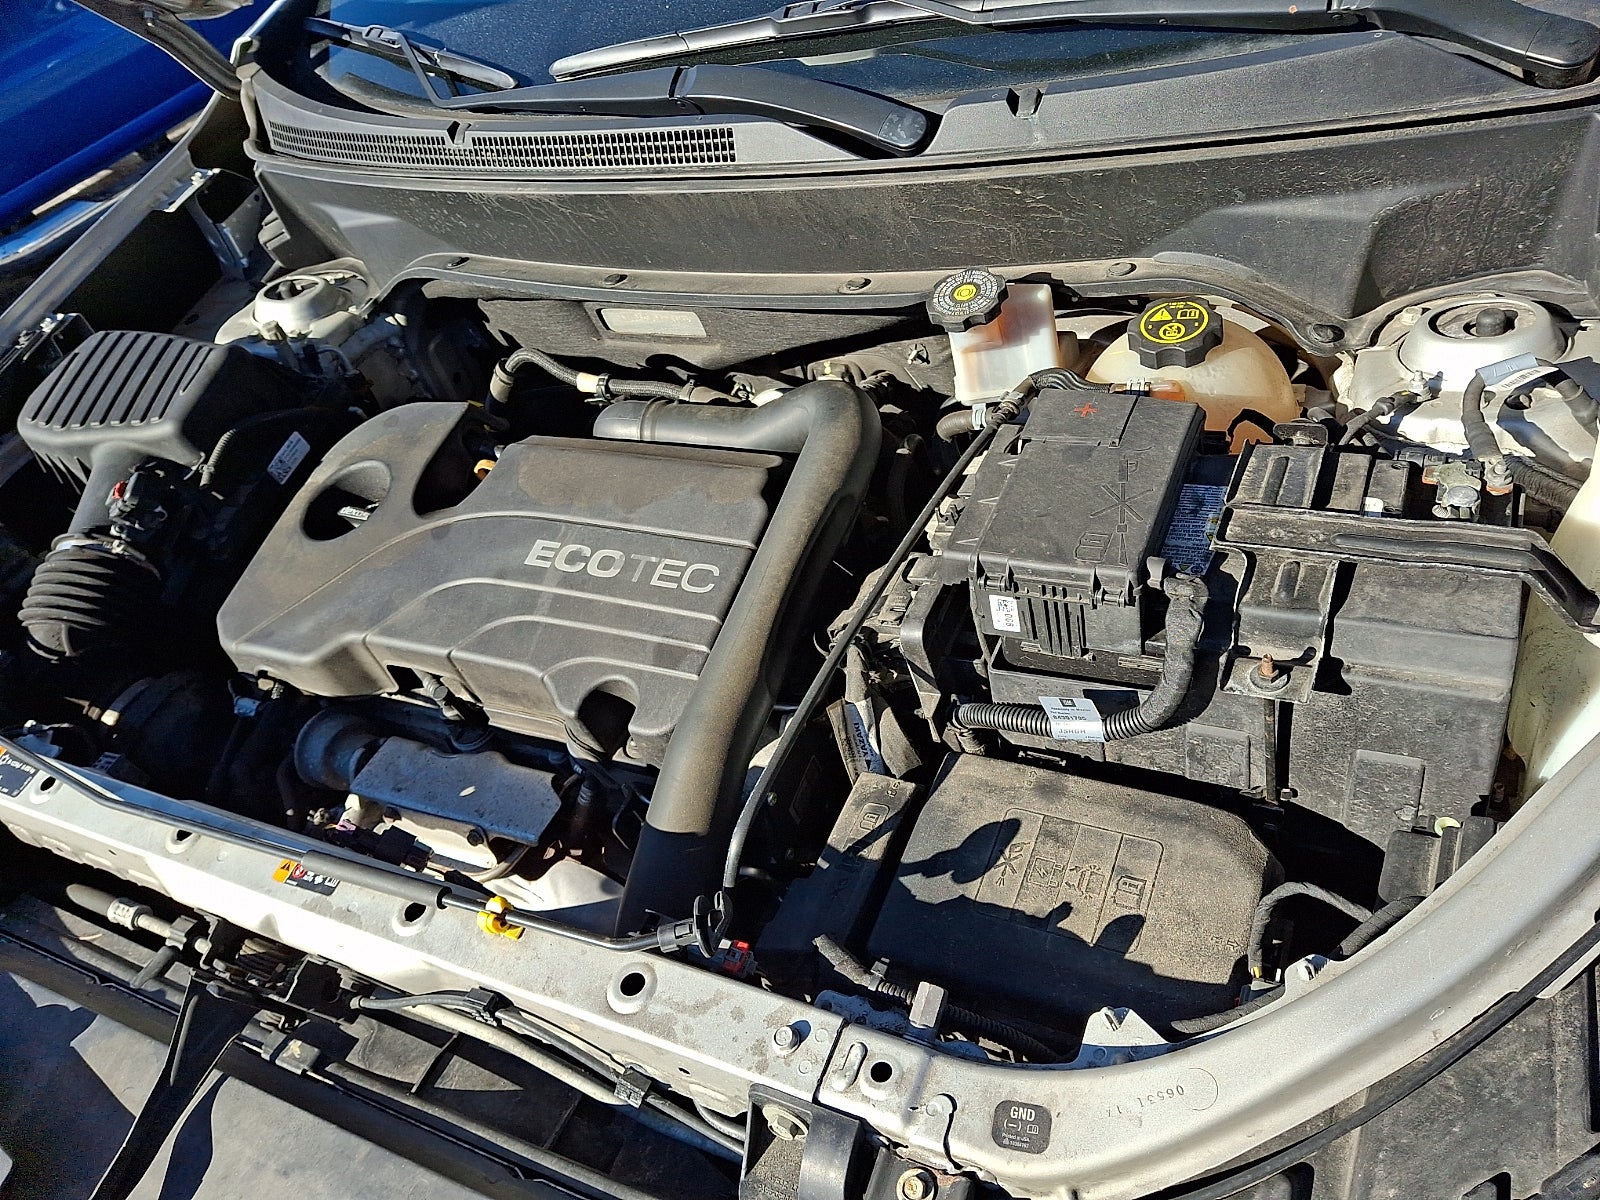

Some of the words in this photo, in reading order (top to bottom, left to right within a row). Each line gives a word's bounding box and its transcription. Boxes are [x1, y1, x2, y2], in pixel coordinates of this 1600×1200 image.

[524, 539, 720, 593] ECOTEC
[853, 722, 868, 758] YAZAKI
[1010, 1106, 1035, 1121] GND
